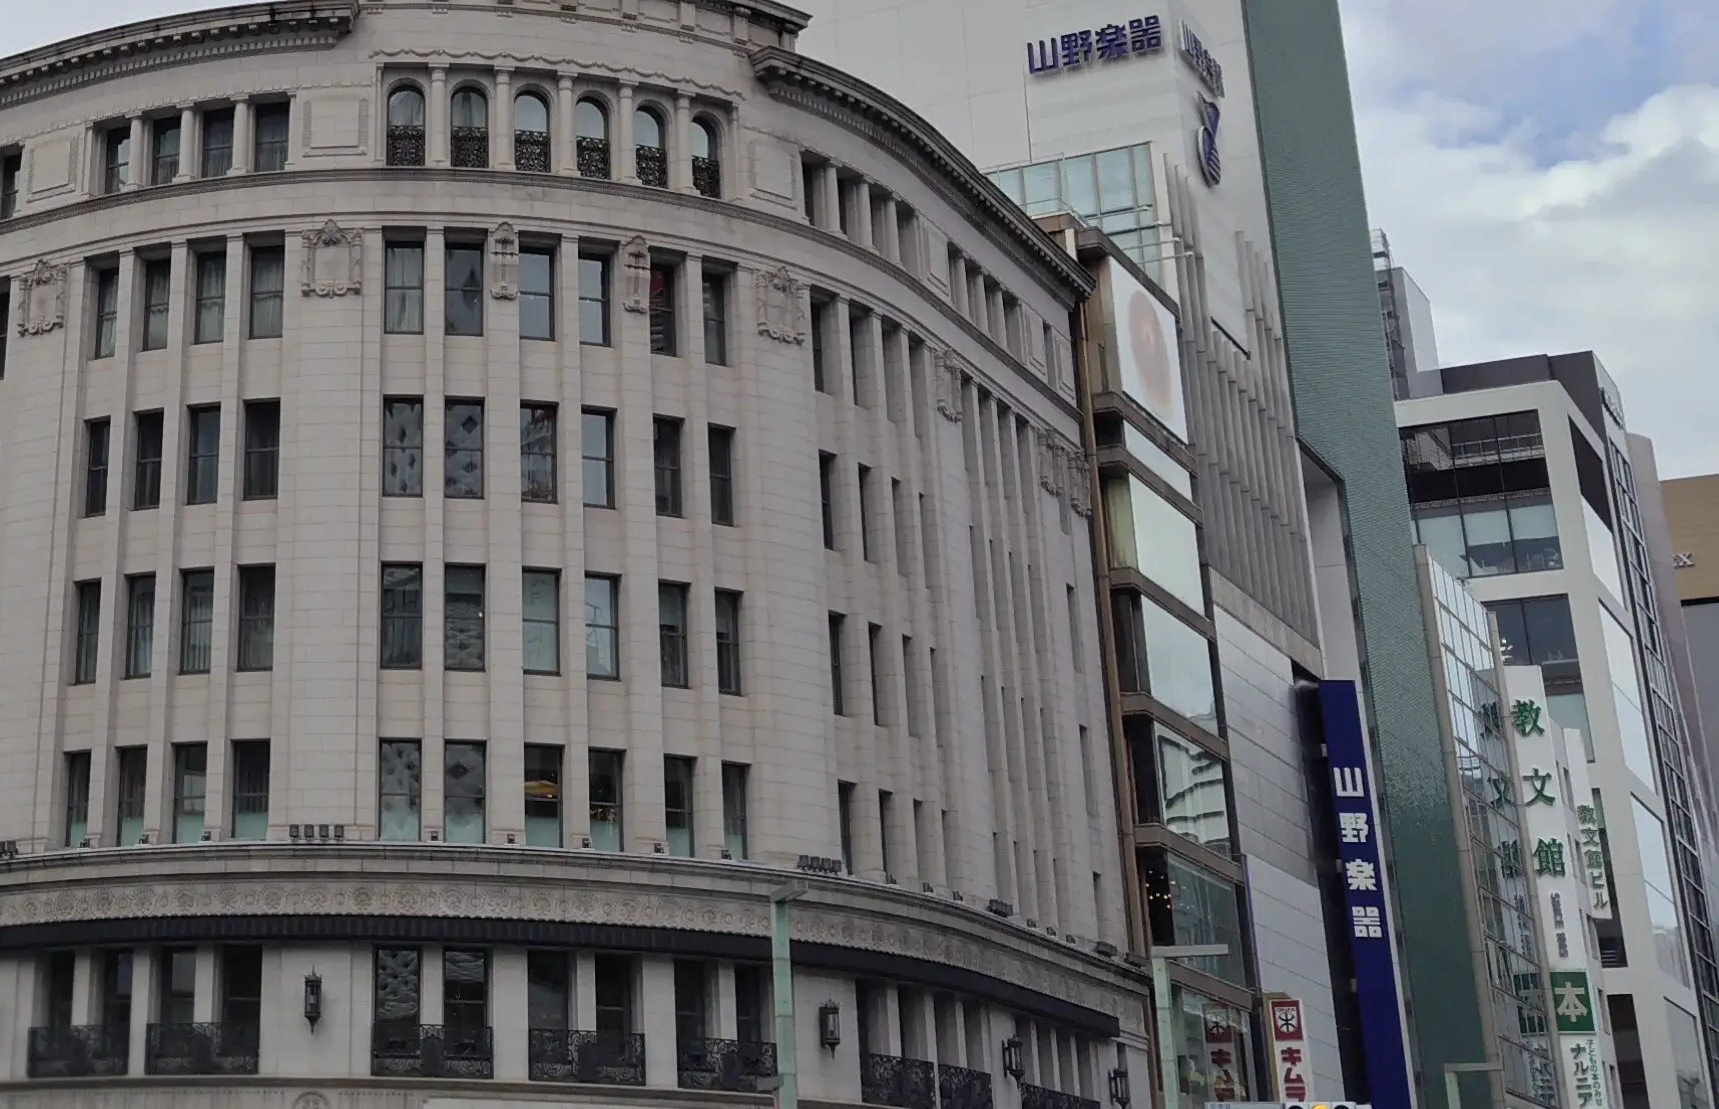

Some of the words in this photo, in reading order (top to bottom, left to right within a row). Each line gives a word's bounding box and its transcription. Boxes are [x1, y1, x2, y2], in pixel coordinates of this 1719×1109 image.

[1027, 14, 1162, 74] 山野楽器
[1512, 698, 1566, 878] 教文館
[1333, 767, 1382, 938] 山野楽器
[1577, 804, 1608, 910] 教文館ビル
[1554, 981, 1588, 1022] 本
[1570, 1043, 1593, 1108] ナルニア
